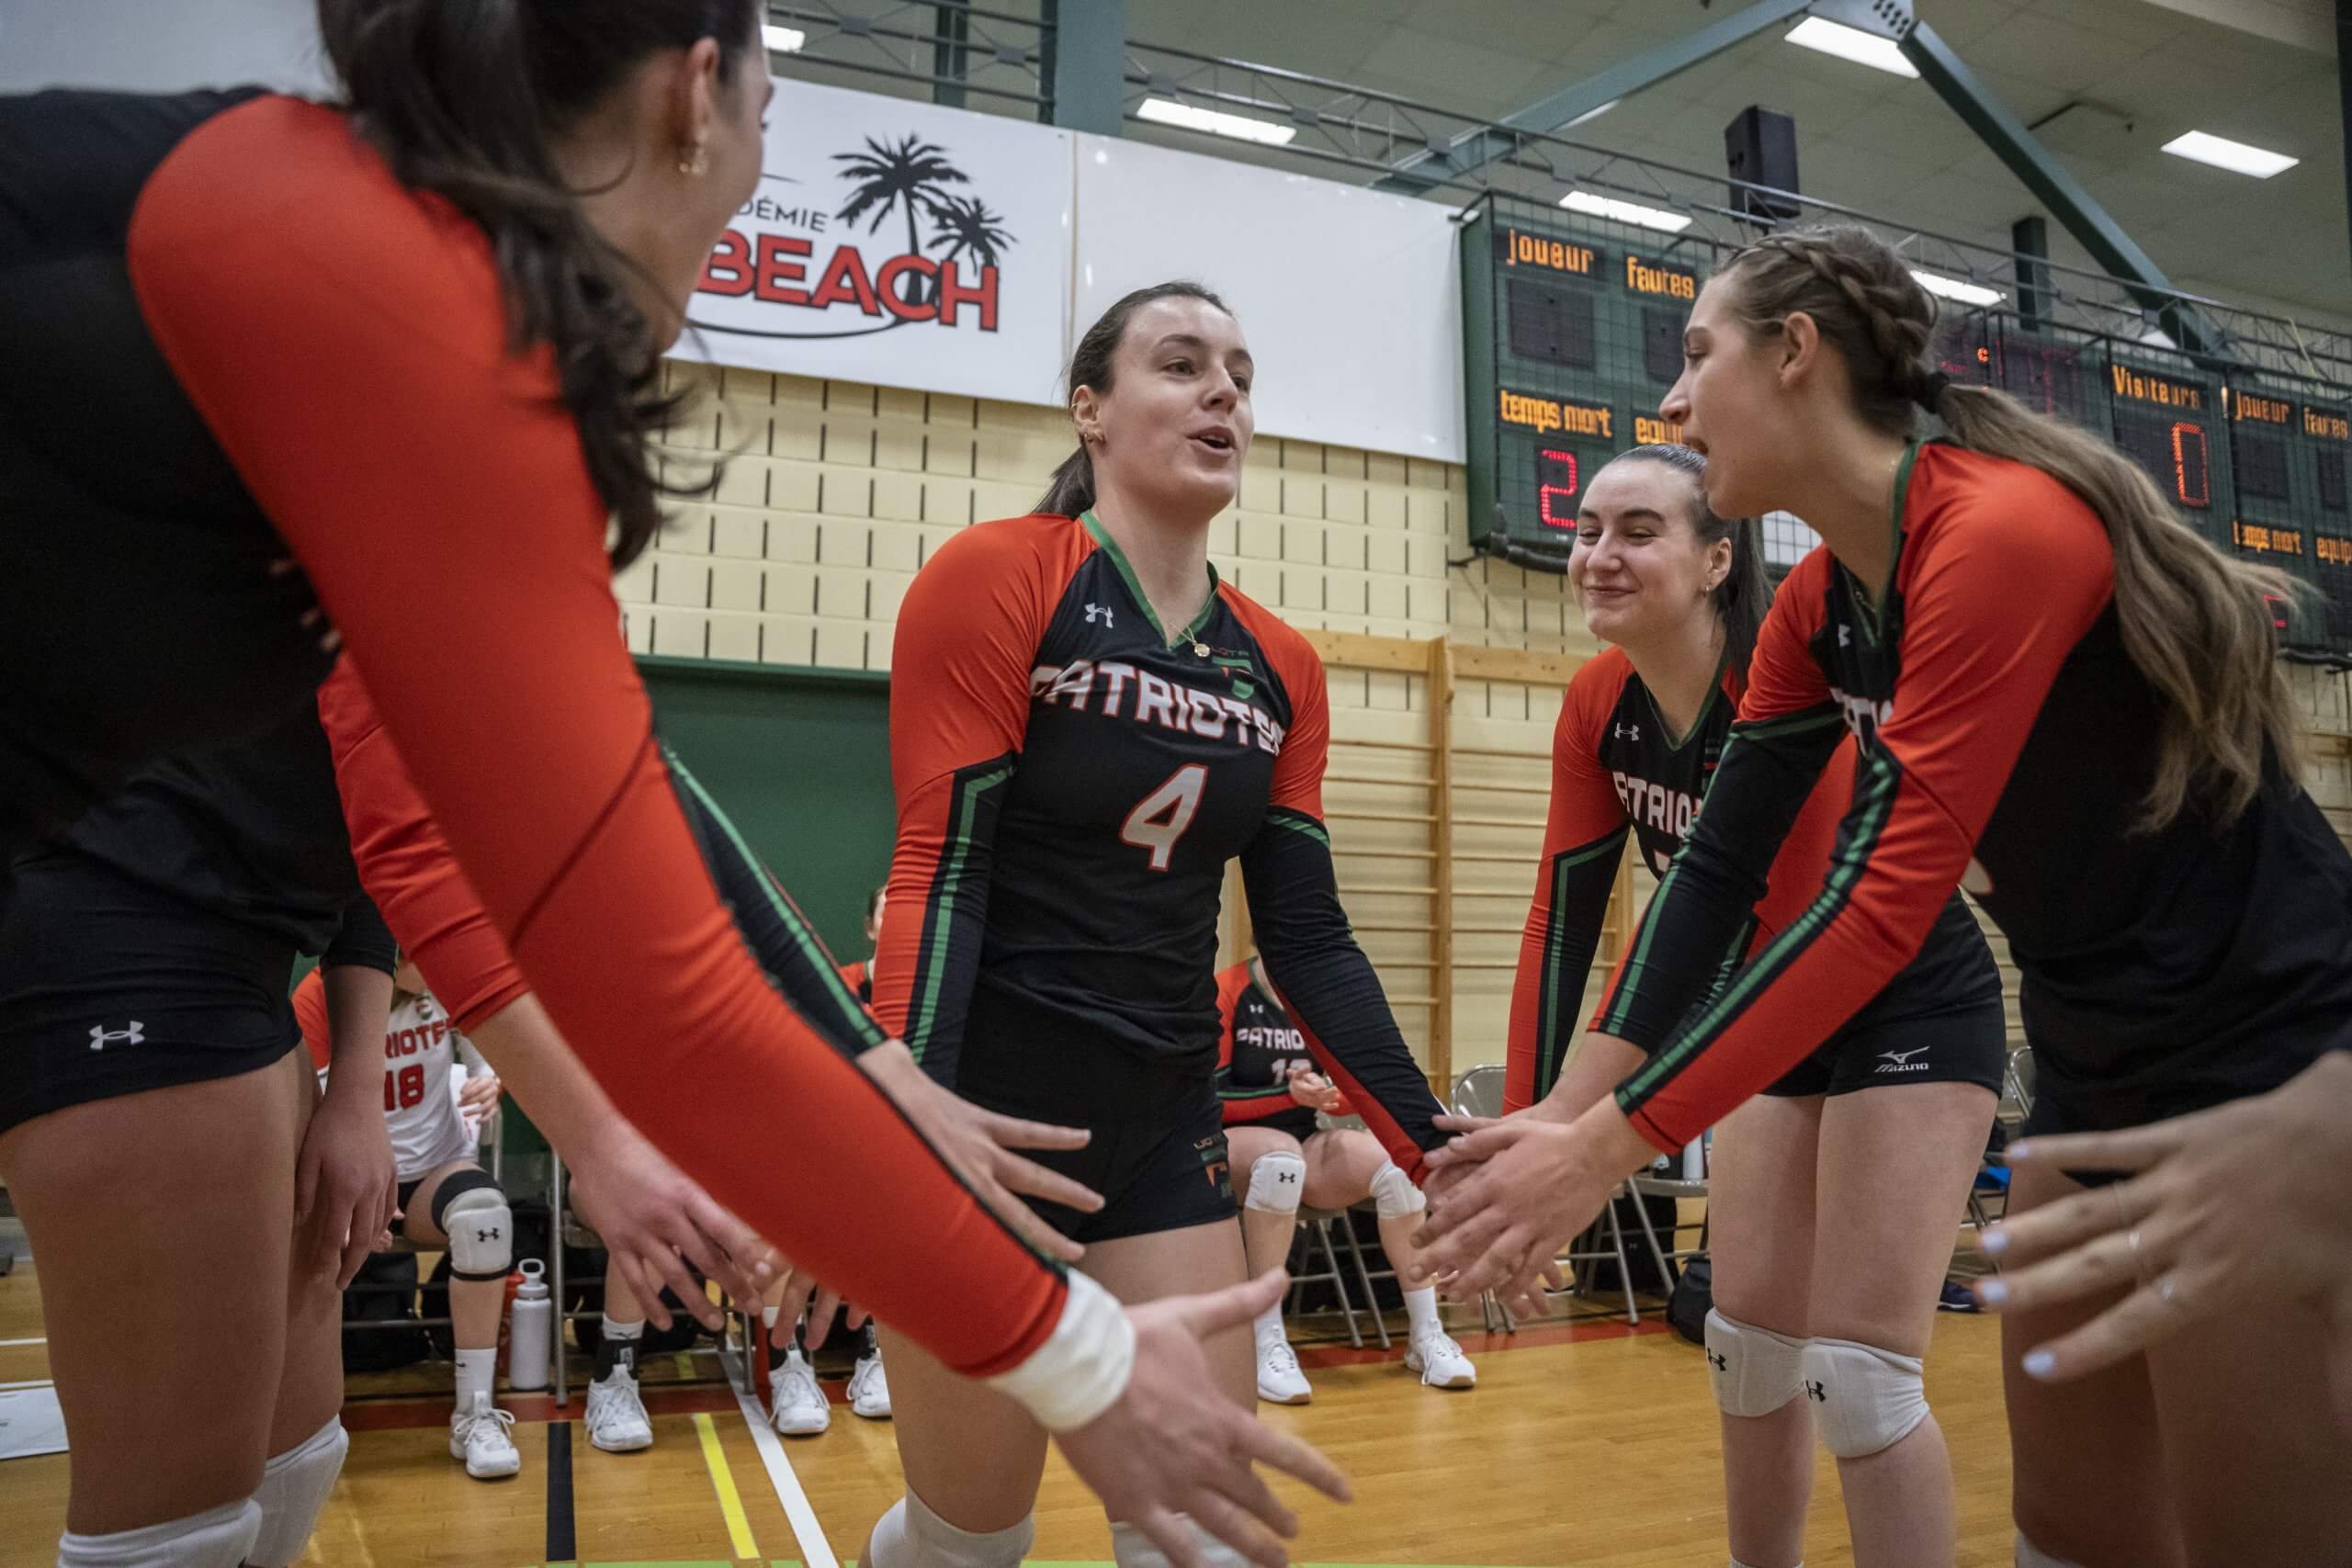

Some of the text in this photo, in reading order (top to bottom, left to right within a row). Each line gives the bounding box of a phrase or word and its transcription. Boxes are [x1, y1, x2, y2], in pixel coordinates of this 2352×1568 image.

[695, 229, 1000, 333] BEACH
[1500, 389, 1613, 438] temps mort
[1540, 450, 1578, 530] 2
[2171, 422, 2210, 507] 0
[1119, 763, 1209, 872] 4
[384, 1063, 425, 1112] 18
